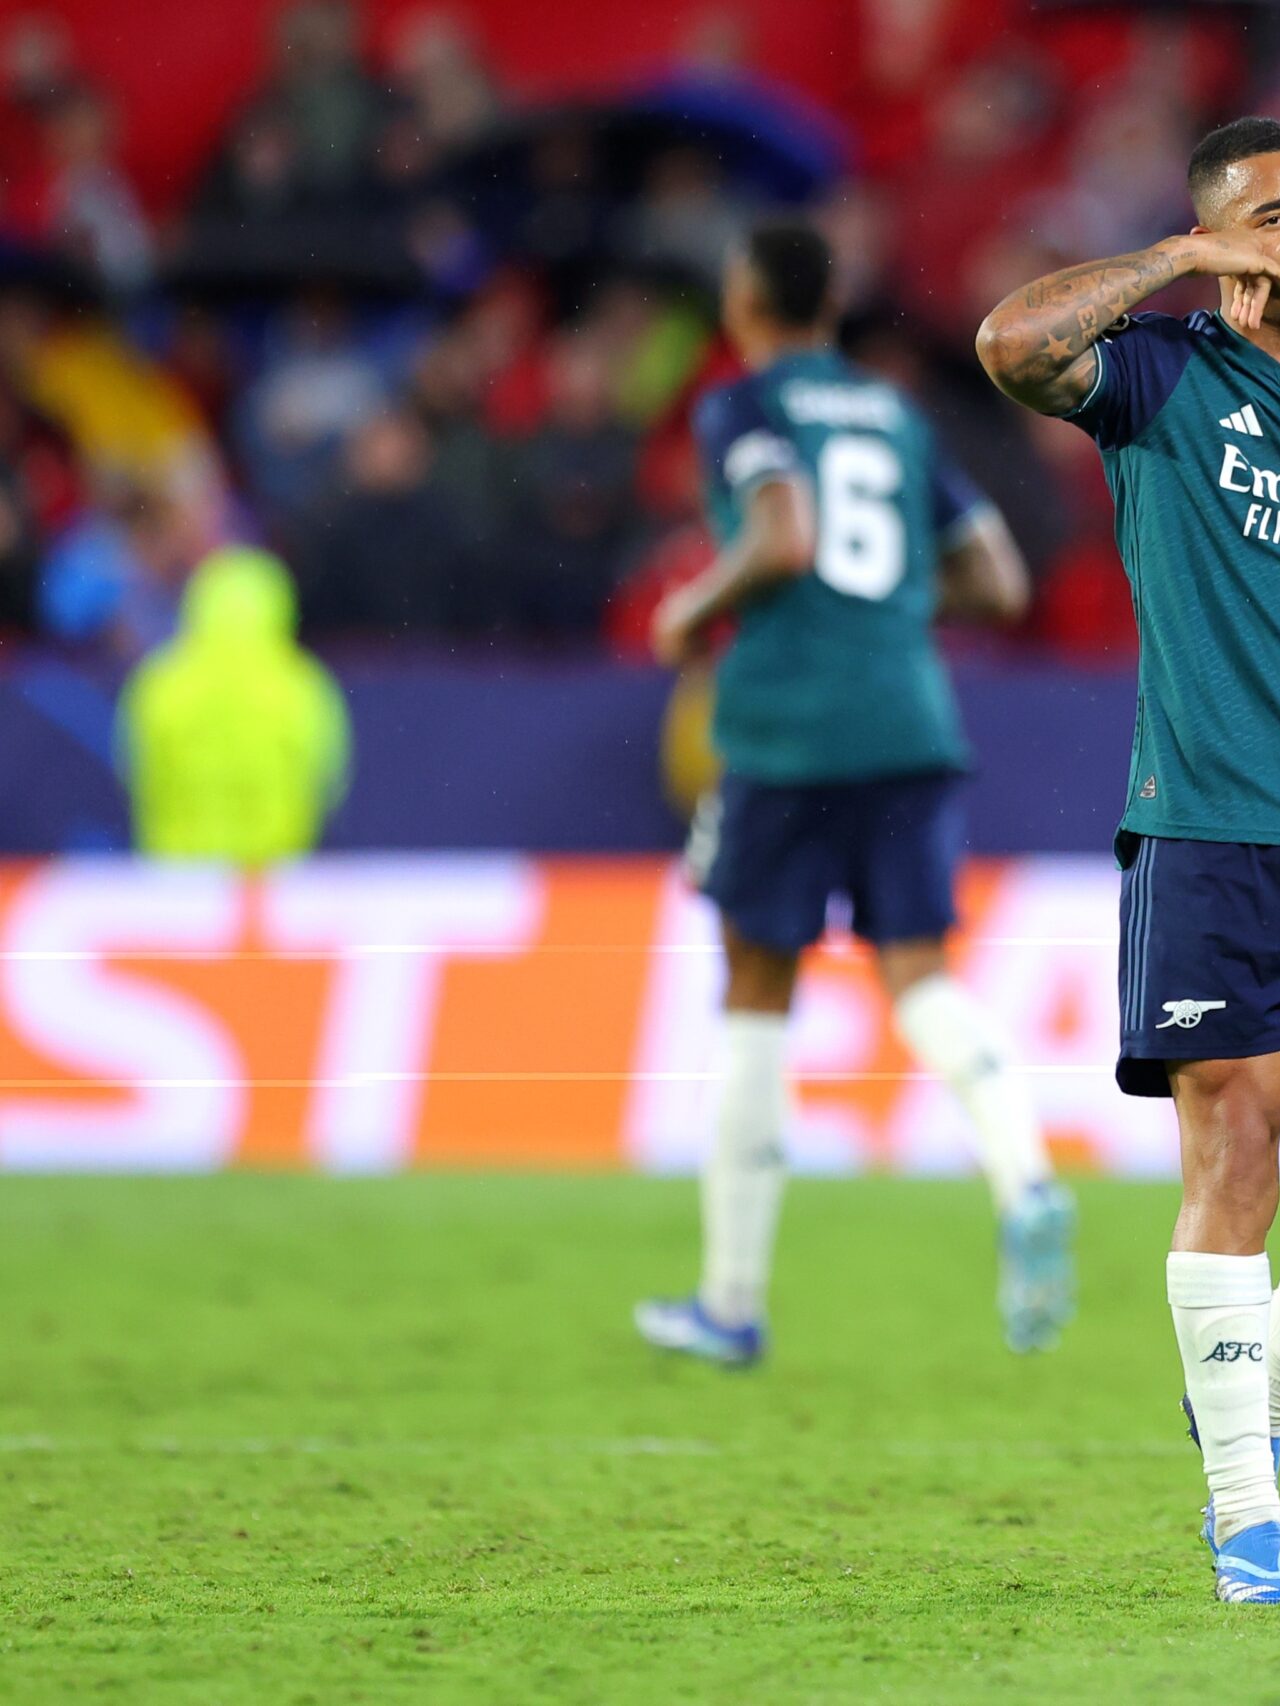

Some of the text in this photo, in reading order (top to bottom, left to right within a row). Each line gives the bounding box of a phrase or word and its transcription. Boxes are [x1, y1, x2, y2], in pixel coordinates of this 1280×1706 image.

[816, 432, 905, 600] 6
[0, 858, 546, 1174] ST
[1200, 1341, 1263, 1363] AFC
